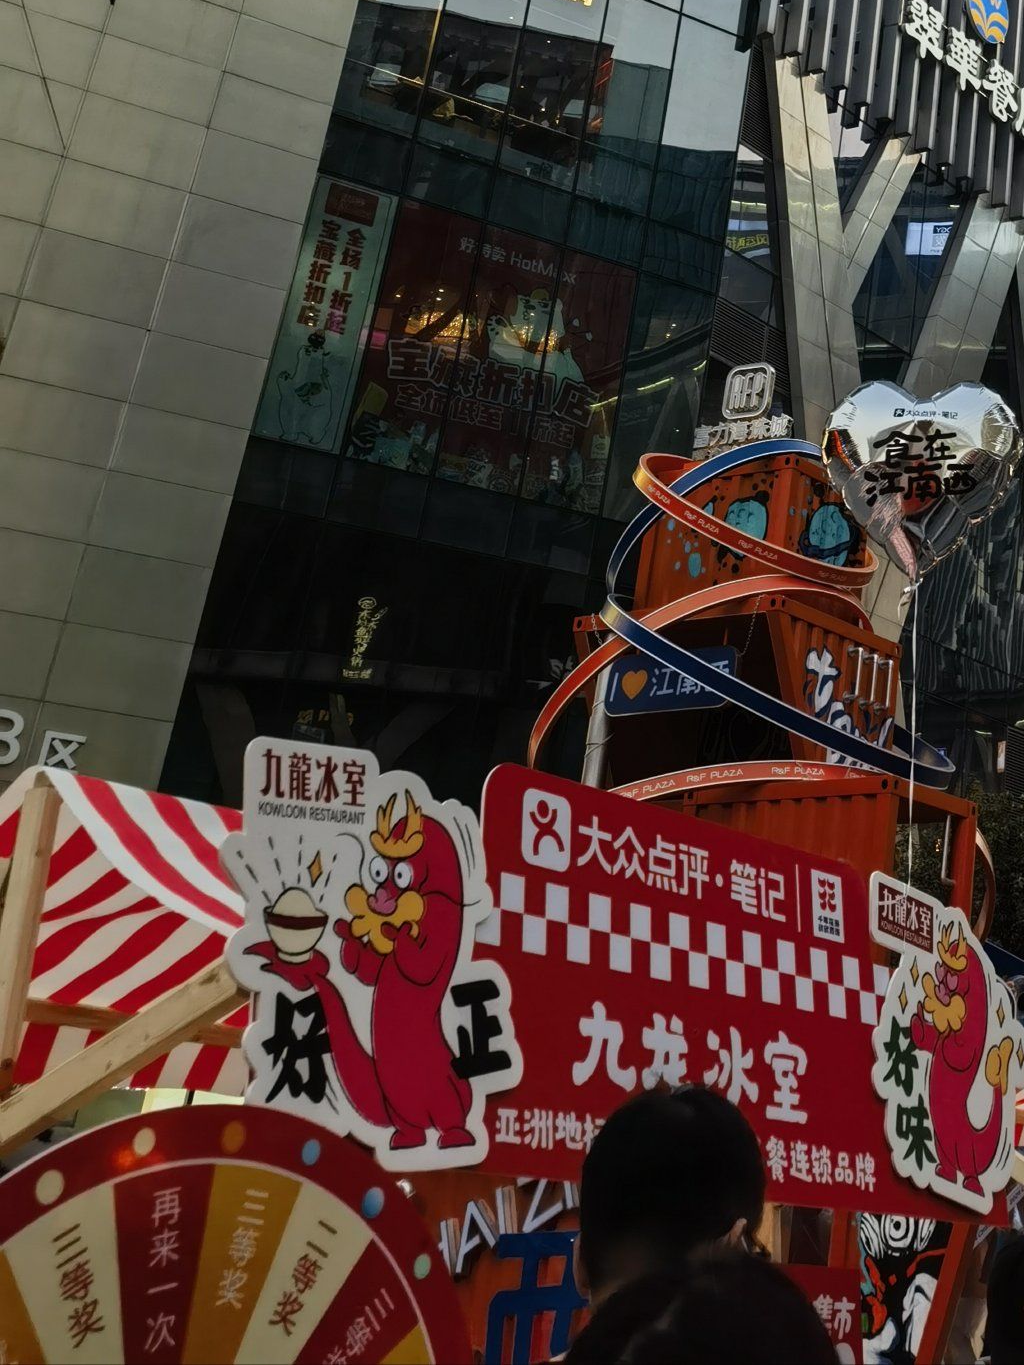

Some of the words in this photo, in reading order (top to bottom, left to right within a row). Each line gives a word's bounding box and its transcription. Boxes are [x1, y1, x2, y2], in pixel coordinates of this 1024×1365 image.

[872, 428, 957, 469] 食在
[863, 461, 978, 508] 江南西
[697, 517, 720, 535] PLAZA
[755, 546, 779, 562] PLAZA
[259, 747, 367, 808] 九龍冰室
[641, 779, 676, 794] PLAZA
[686, 771, 707, 784] R&F
[709, 768, 744, 780] PLAZA
[771, 765, 791, 775] R&F
[794, 766, 825, 776] PLAZA
[257, 801, 307, 821] KOWLOON
[309, 806, 366, 825] RESTAURANT
[576, 815, 787, 923] 大众点评·笔记
[261, 990, 332, 1104] 好
[450, 978, 513, 1080] 正
[571, 1000, 809, 1125] 九龙冰室
[881, 1015, 939, 1171] 好味
[144, 1185, 183, 1352] 再来一次
[214, 1187, 270, 1310] 三等奖
[267, 1219, 338, 1337] 二等奖
[52, 1222, 106, 1350] 三等奖
